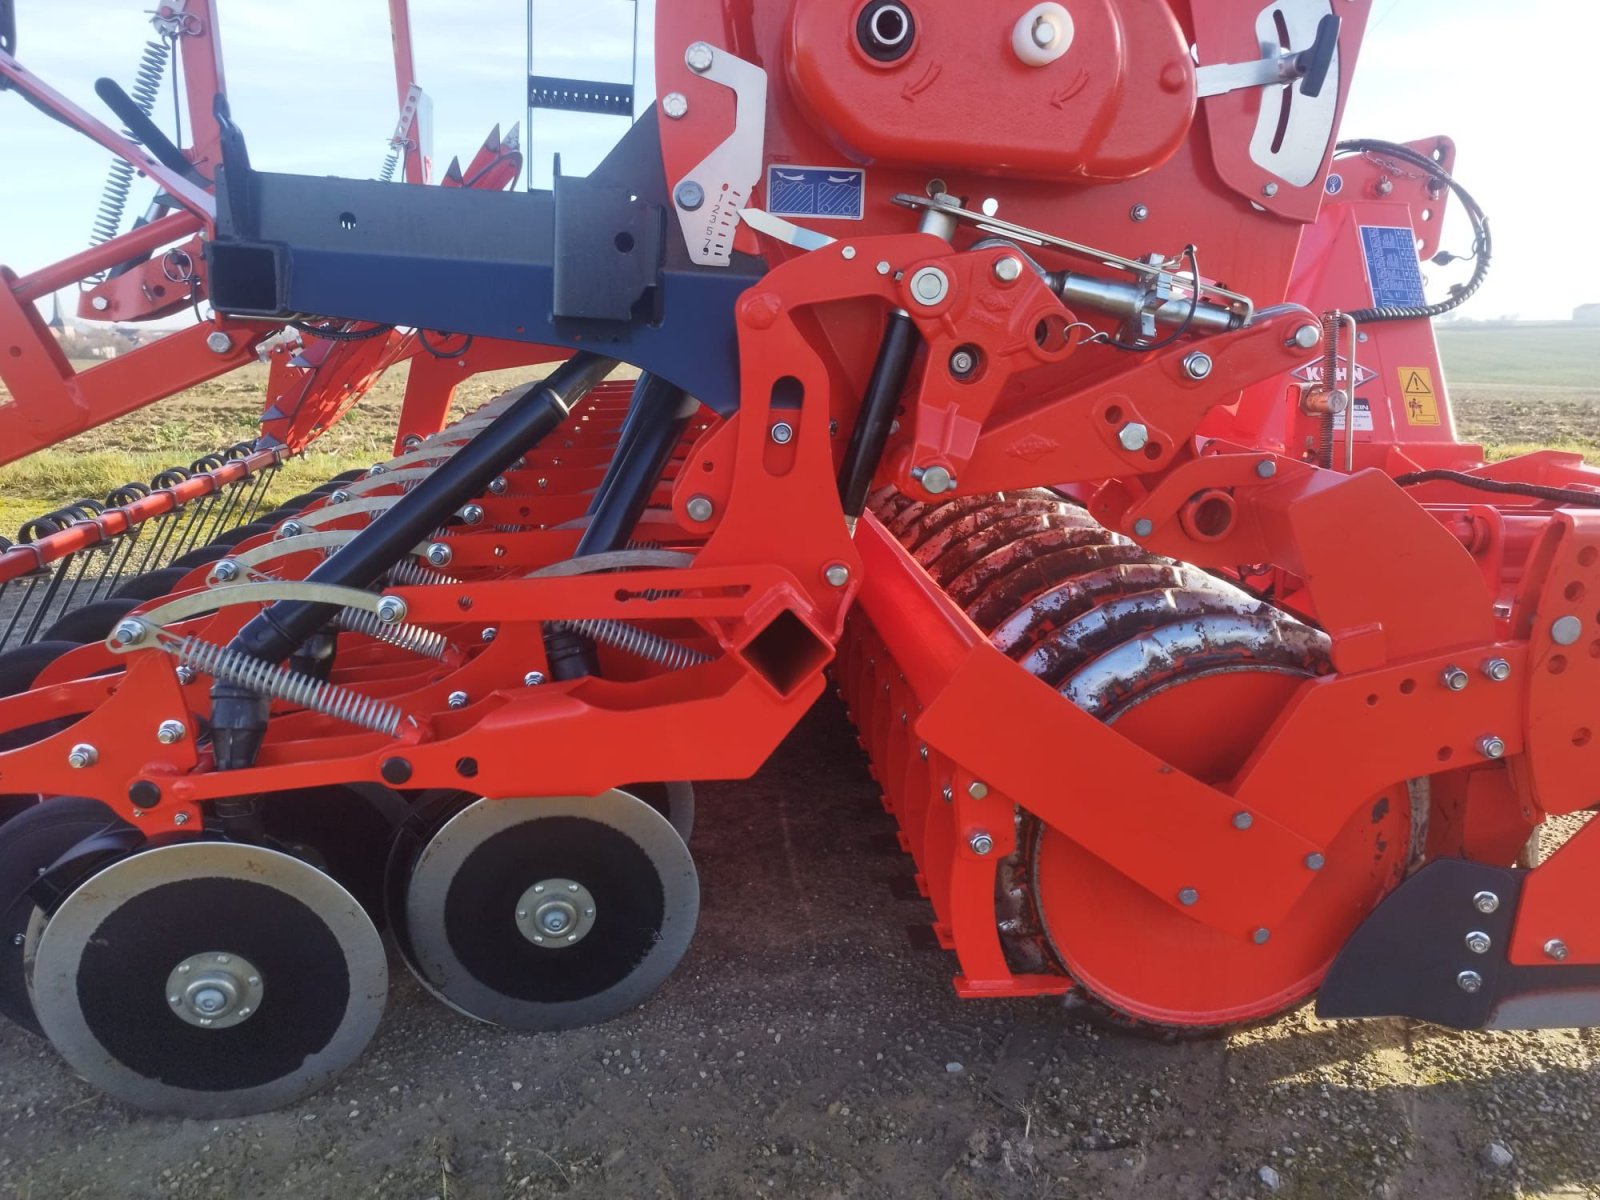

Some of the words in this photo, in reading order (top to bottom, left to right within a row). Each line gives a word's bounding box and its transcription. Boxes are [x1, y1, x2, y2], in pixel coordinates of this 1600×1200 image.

[712, 205, 720, 214] 2
[710, 215, 716, 223] 3
[706, 227, 713, 235] 5
[705, 238, 711, 247] 7
